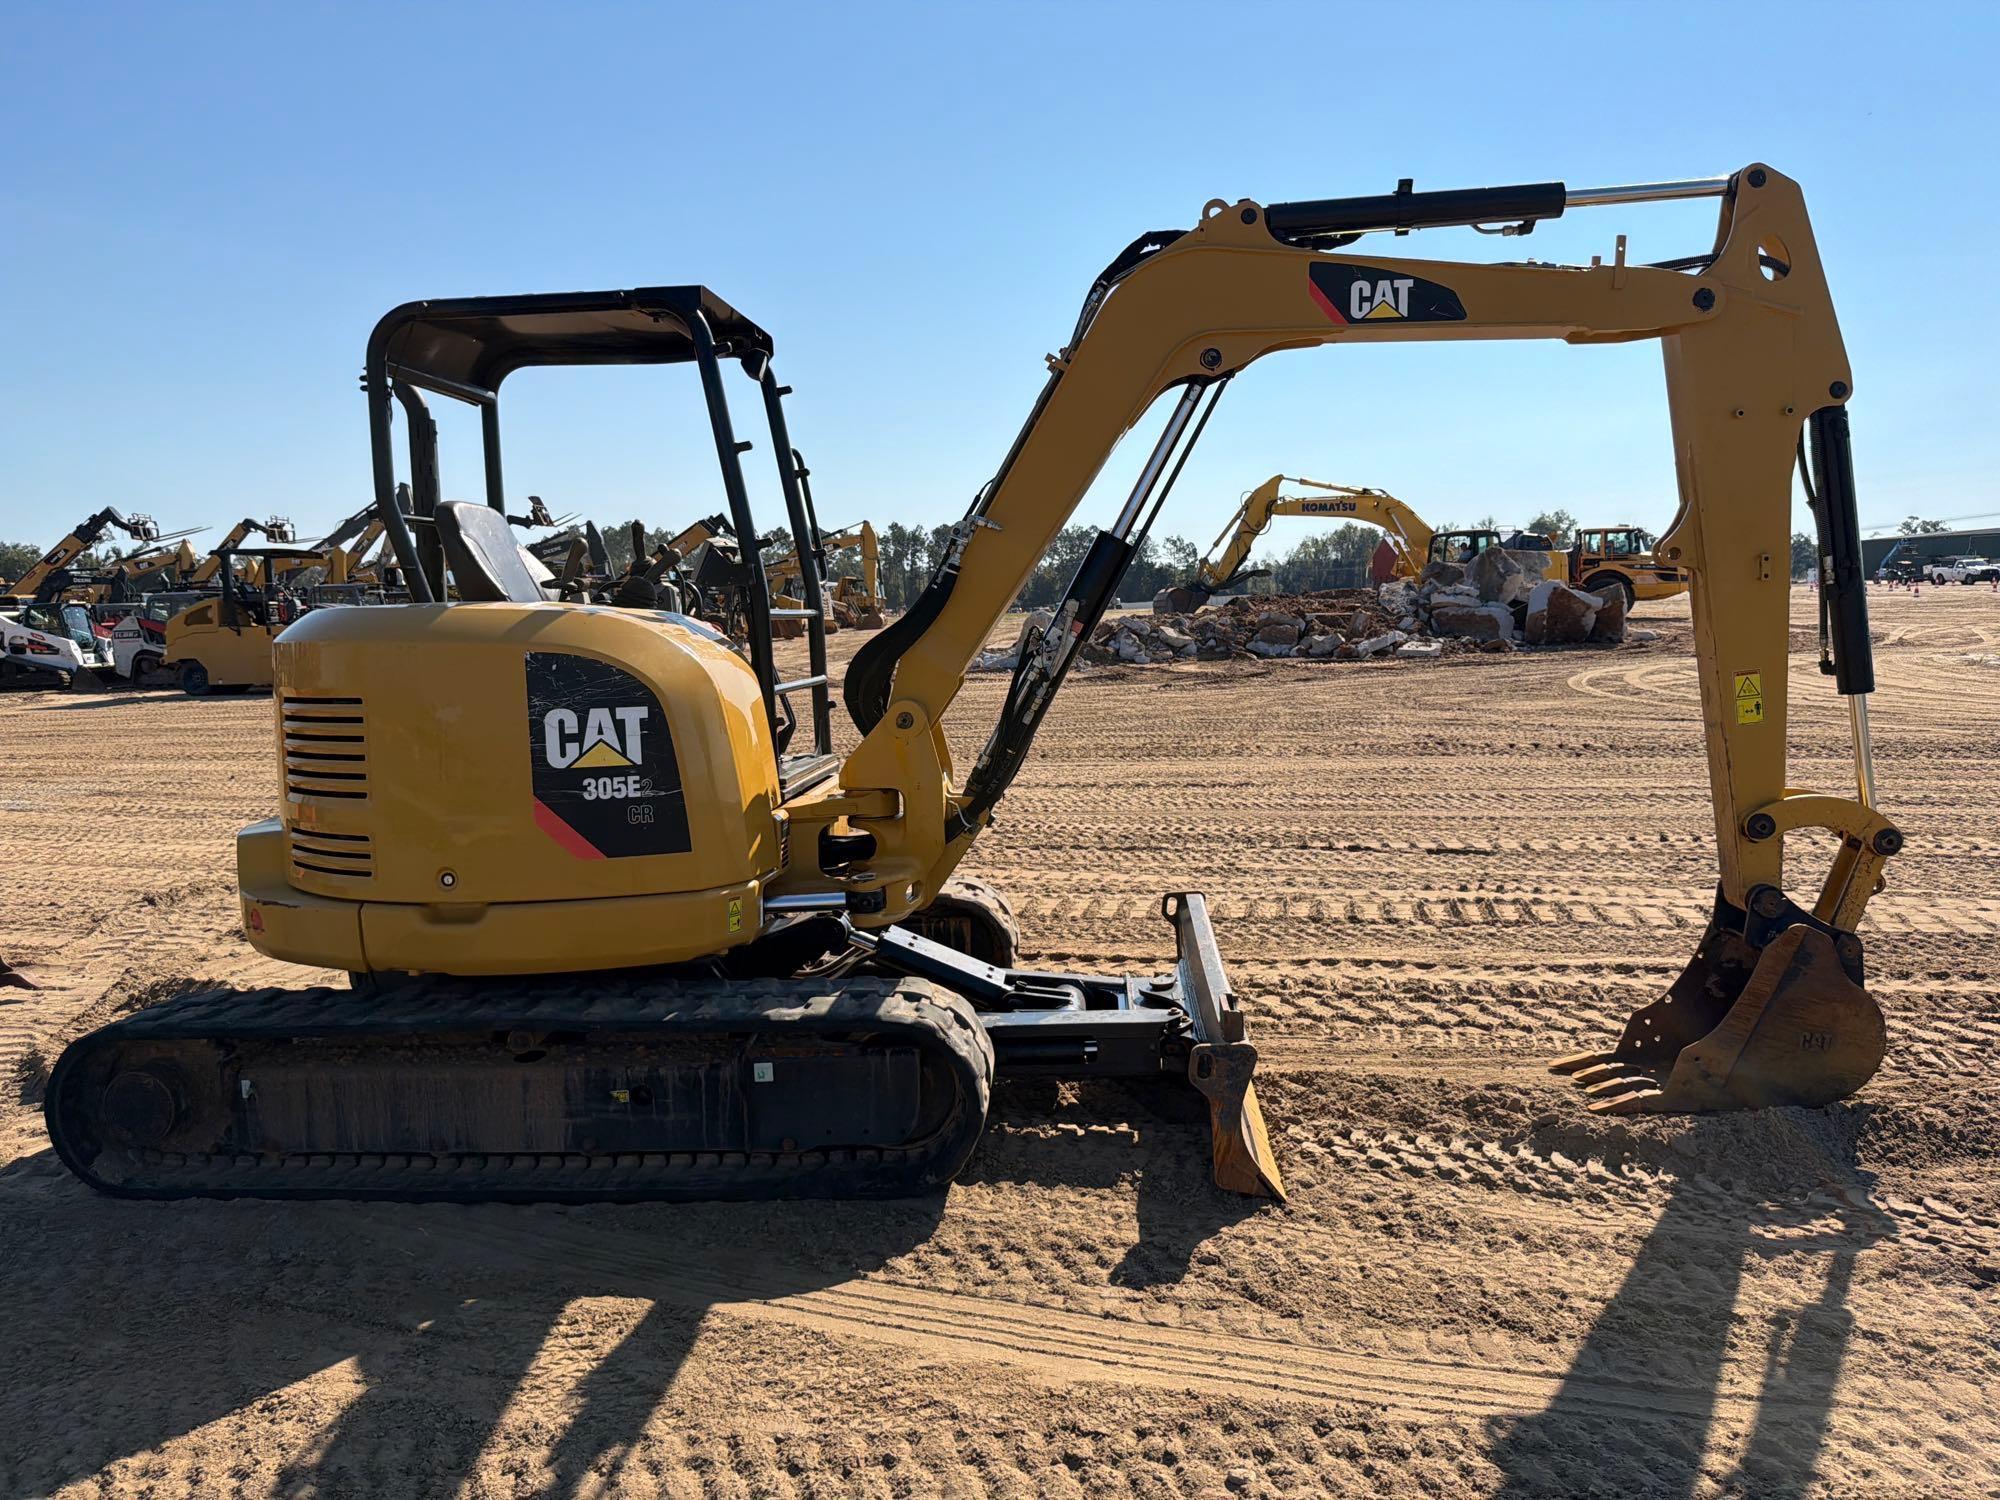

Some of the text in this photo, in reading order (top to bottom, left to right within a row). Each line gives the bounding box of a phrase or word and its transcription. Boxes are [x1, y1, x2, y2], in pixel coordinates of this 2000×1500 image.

[1350, 278, 1414, 319] CAT
[1301, 502, 1357, 512] KOMATSU
[544, 706, 649, 769] CAT
[582, 775, 653, 801] 305E2
[627, 804, 654, 824] CR
